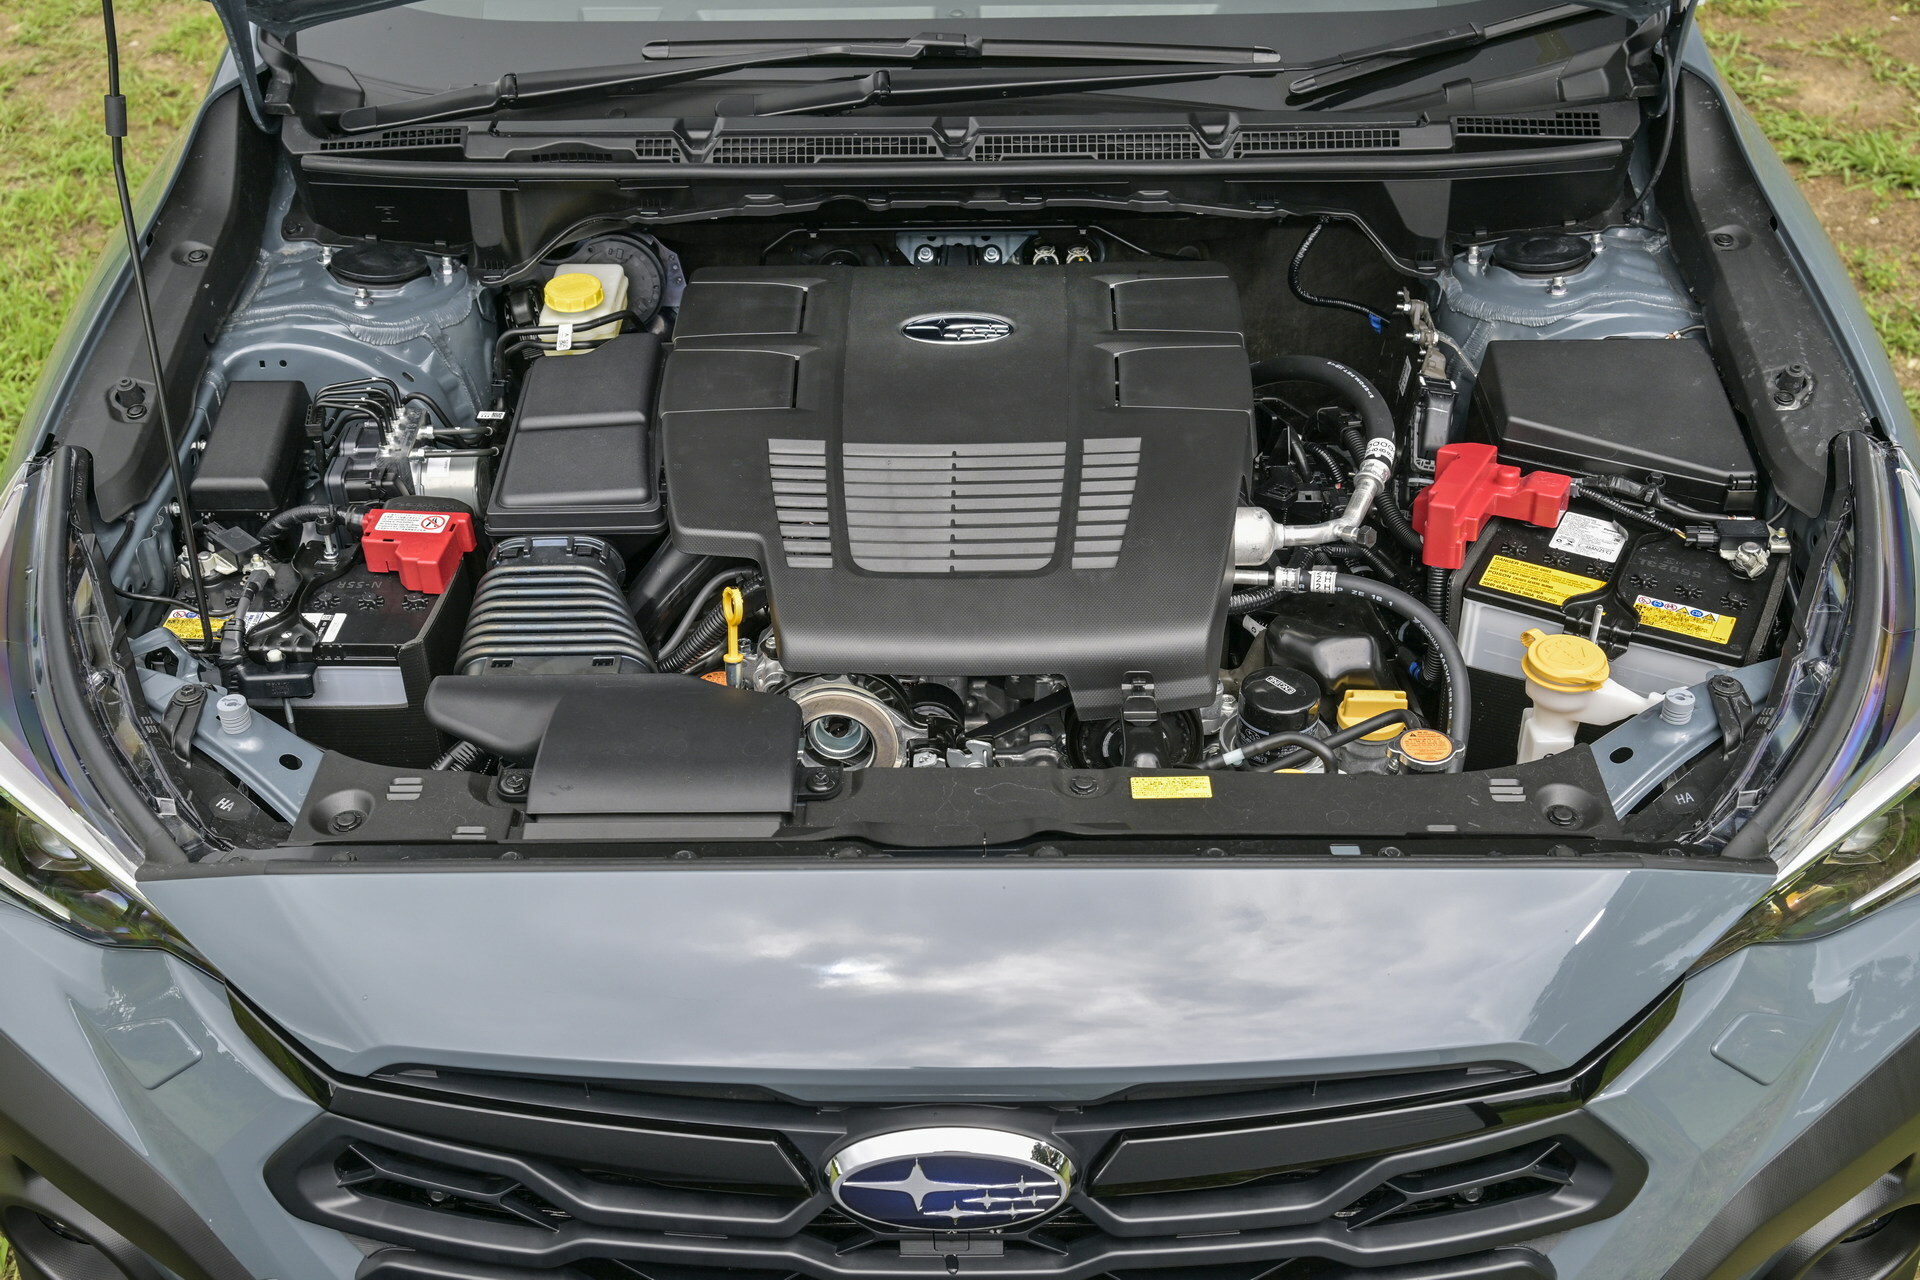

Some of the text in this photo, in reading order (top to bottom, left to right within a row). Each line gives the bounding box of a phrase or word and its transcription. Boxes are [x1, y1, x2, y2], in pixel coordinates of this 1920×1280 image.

[1494, 556, 1519, 565] DANGER
[1487, 569, 1511, 578] POISON
[1420, 622, 1440, 651] YOKOHAMA
[216, 797, 235, 812] HA
[1675, 792, 1695, 805] HA
